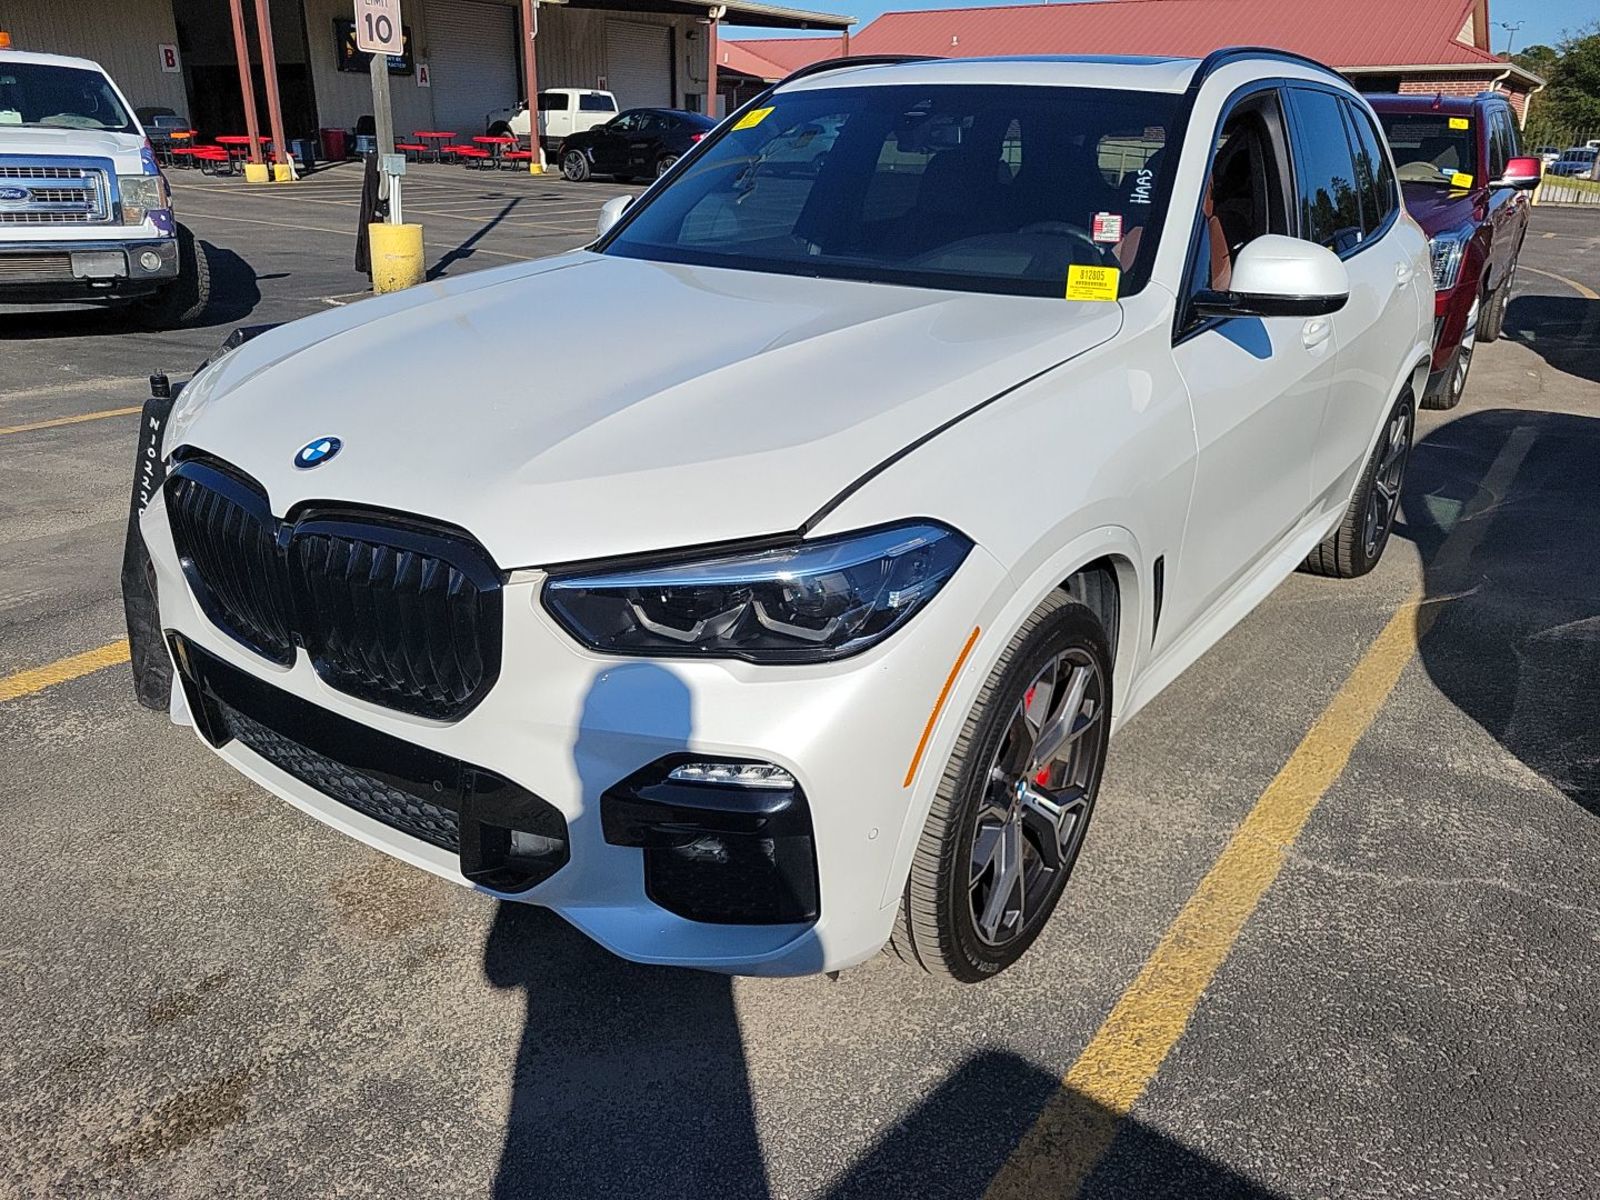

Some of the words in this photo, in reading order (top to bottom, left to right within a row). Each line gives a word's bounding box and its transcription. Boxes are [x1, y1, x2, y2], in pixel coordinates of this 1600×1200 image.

[365, 13, 393, 44] 10
[164, 48, 176, 67] B
[420, 67, 428, 83] A
[1130, 169, 1153, 204] HAAS
